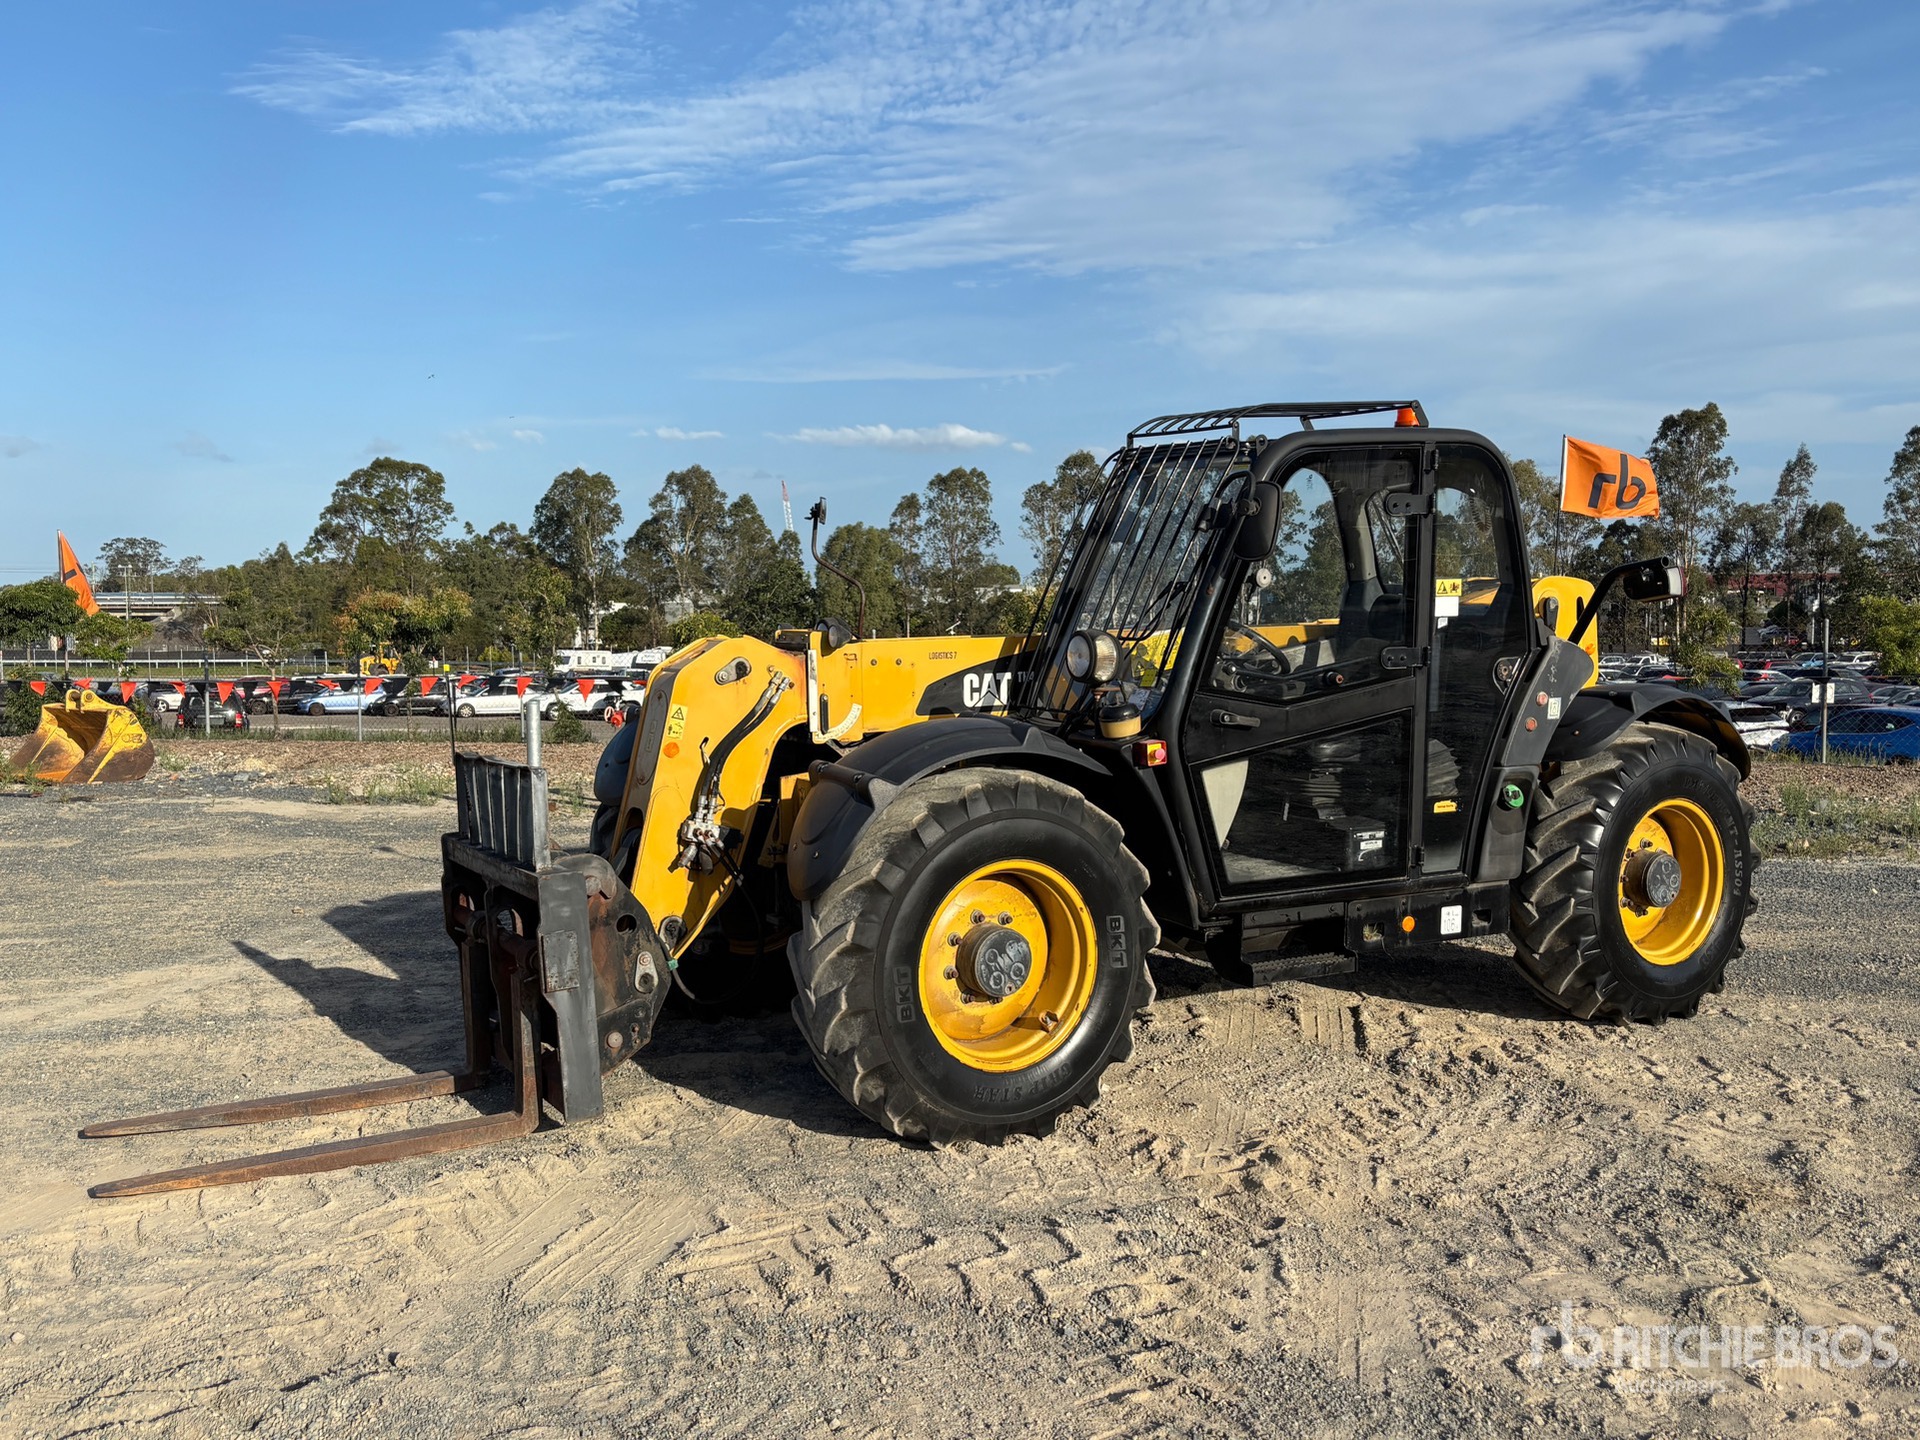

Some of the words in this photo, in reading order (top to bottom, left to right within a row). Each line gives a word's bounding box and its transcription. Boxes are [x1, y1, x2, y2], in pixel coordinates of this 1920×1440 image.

[1588, 453, 1646, 510] rb
[929, 652, 953, 660] LOGISTICS
[963, 672, 1012, 708] CAT
[1107, 916, 1127, 967] BKT
[894, 967, 915, 1022] BKT
